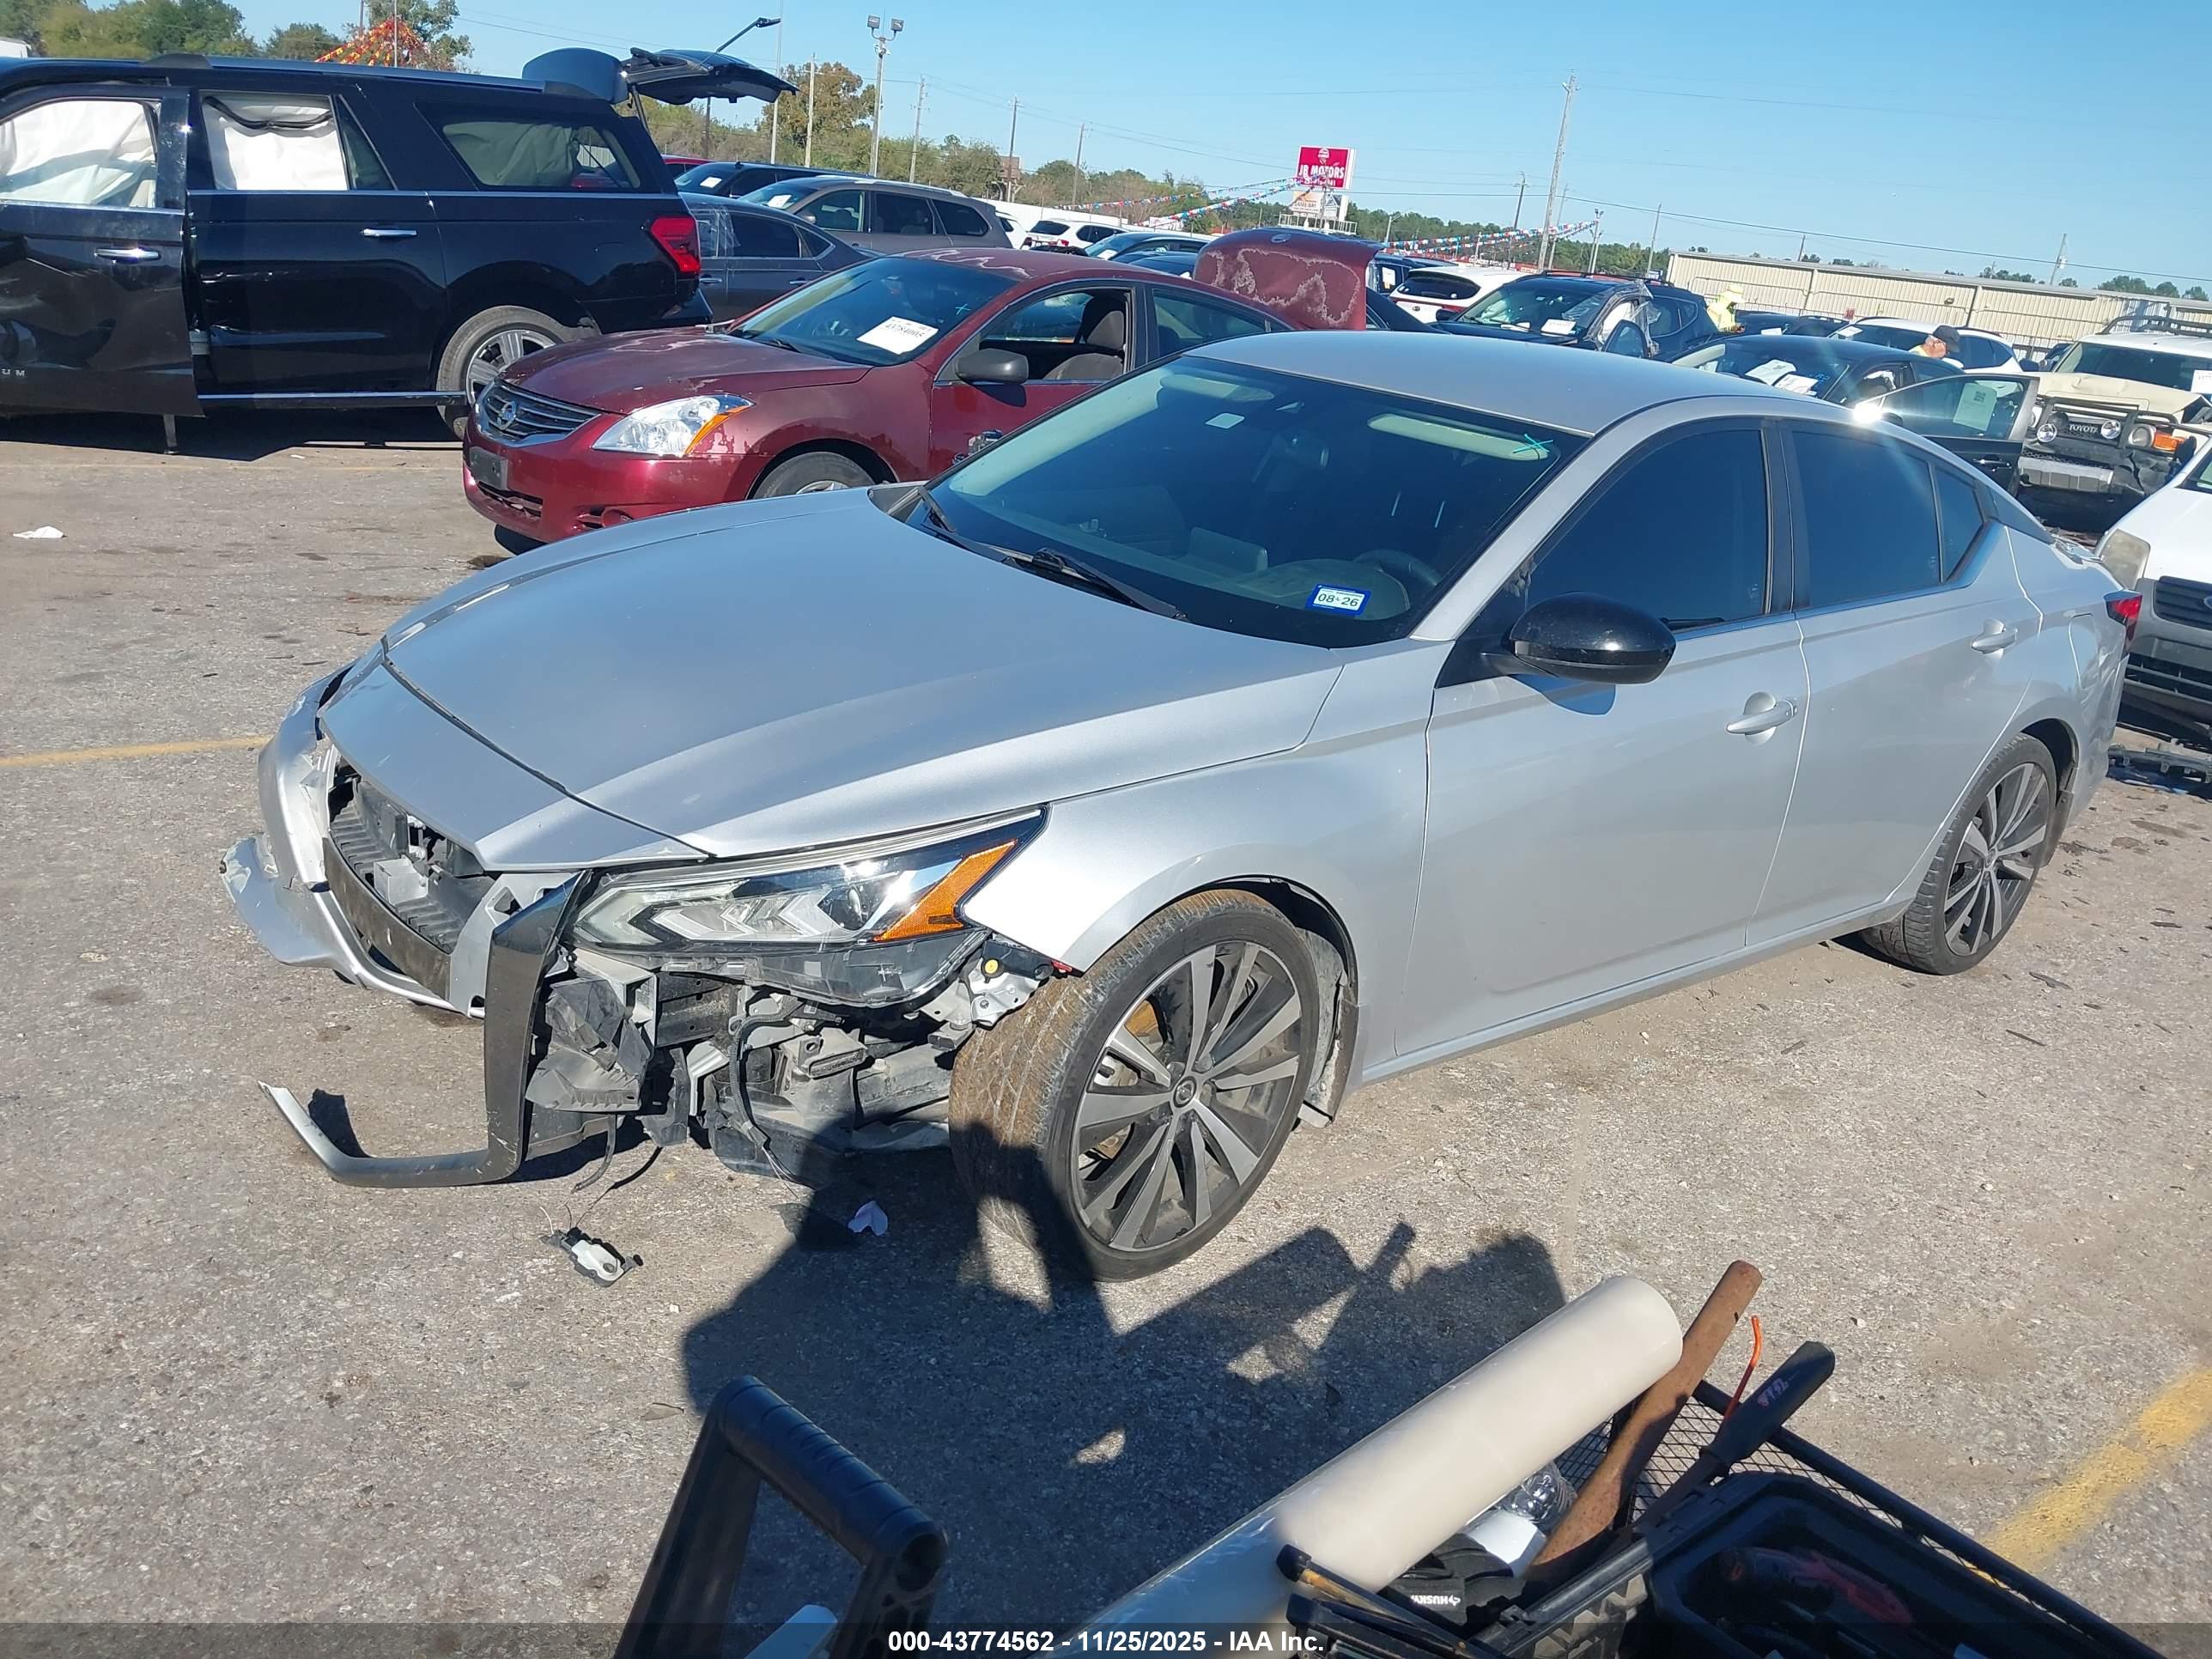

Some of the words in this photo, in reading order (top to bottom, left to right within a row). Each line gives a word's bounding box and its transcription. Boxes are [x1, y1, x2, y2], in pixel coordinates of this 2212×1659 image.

[1298, 164, 1310, 177] JB
[1310, 164, 1345, 179] MOTORS
[1318, 593, 1335, 603] 08
[1340, 597, 1359, 607] 26
